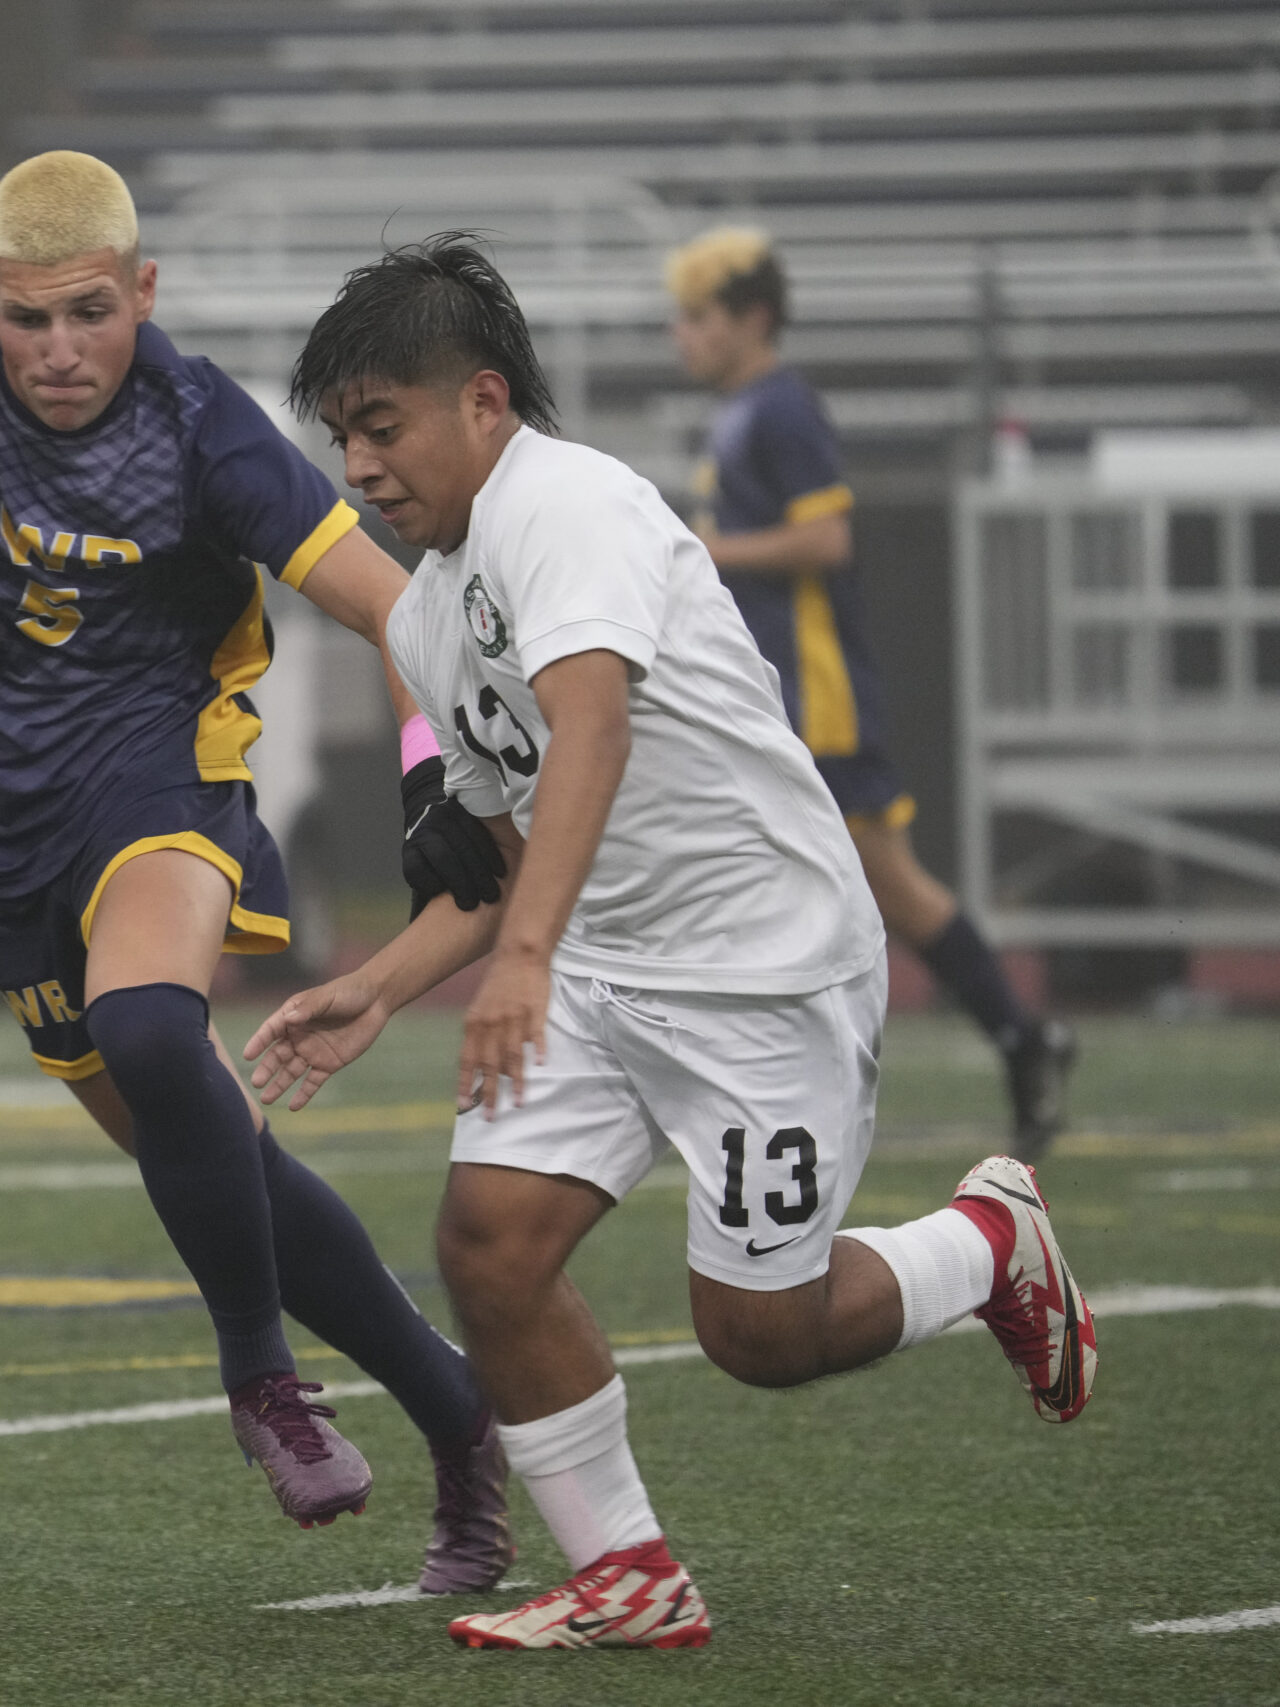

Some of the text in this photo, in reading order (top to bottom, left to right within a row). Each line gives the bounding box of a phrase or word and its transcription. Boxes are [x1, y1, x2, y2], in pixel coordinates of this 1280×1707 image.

[15, 579, 84, 648] 5
[453, 684, 540, 788] 13
[718, 1126, 819, 1228] 13
